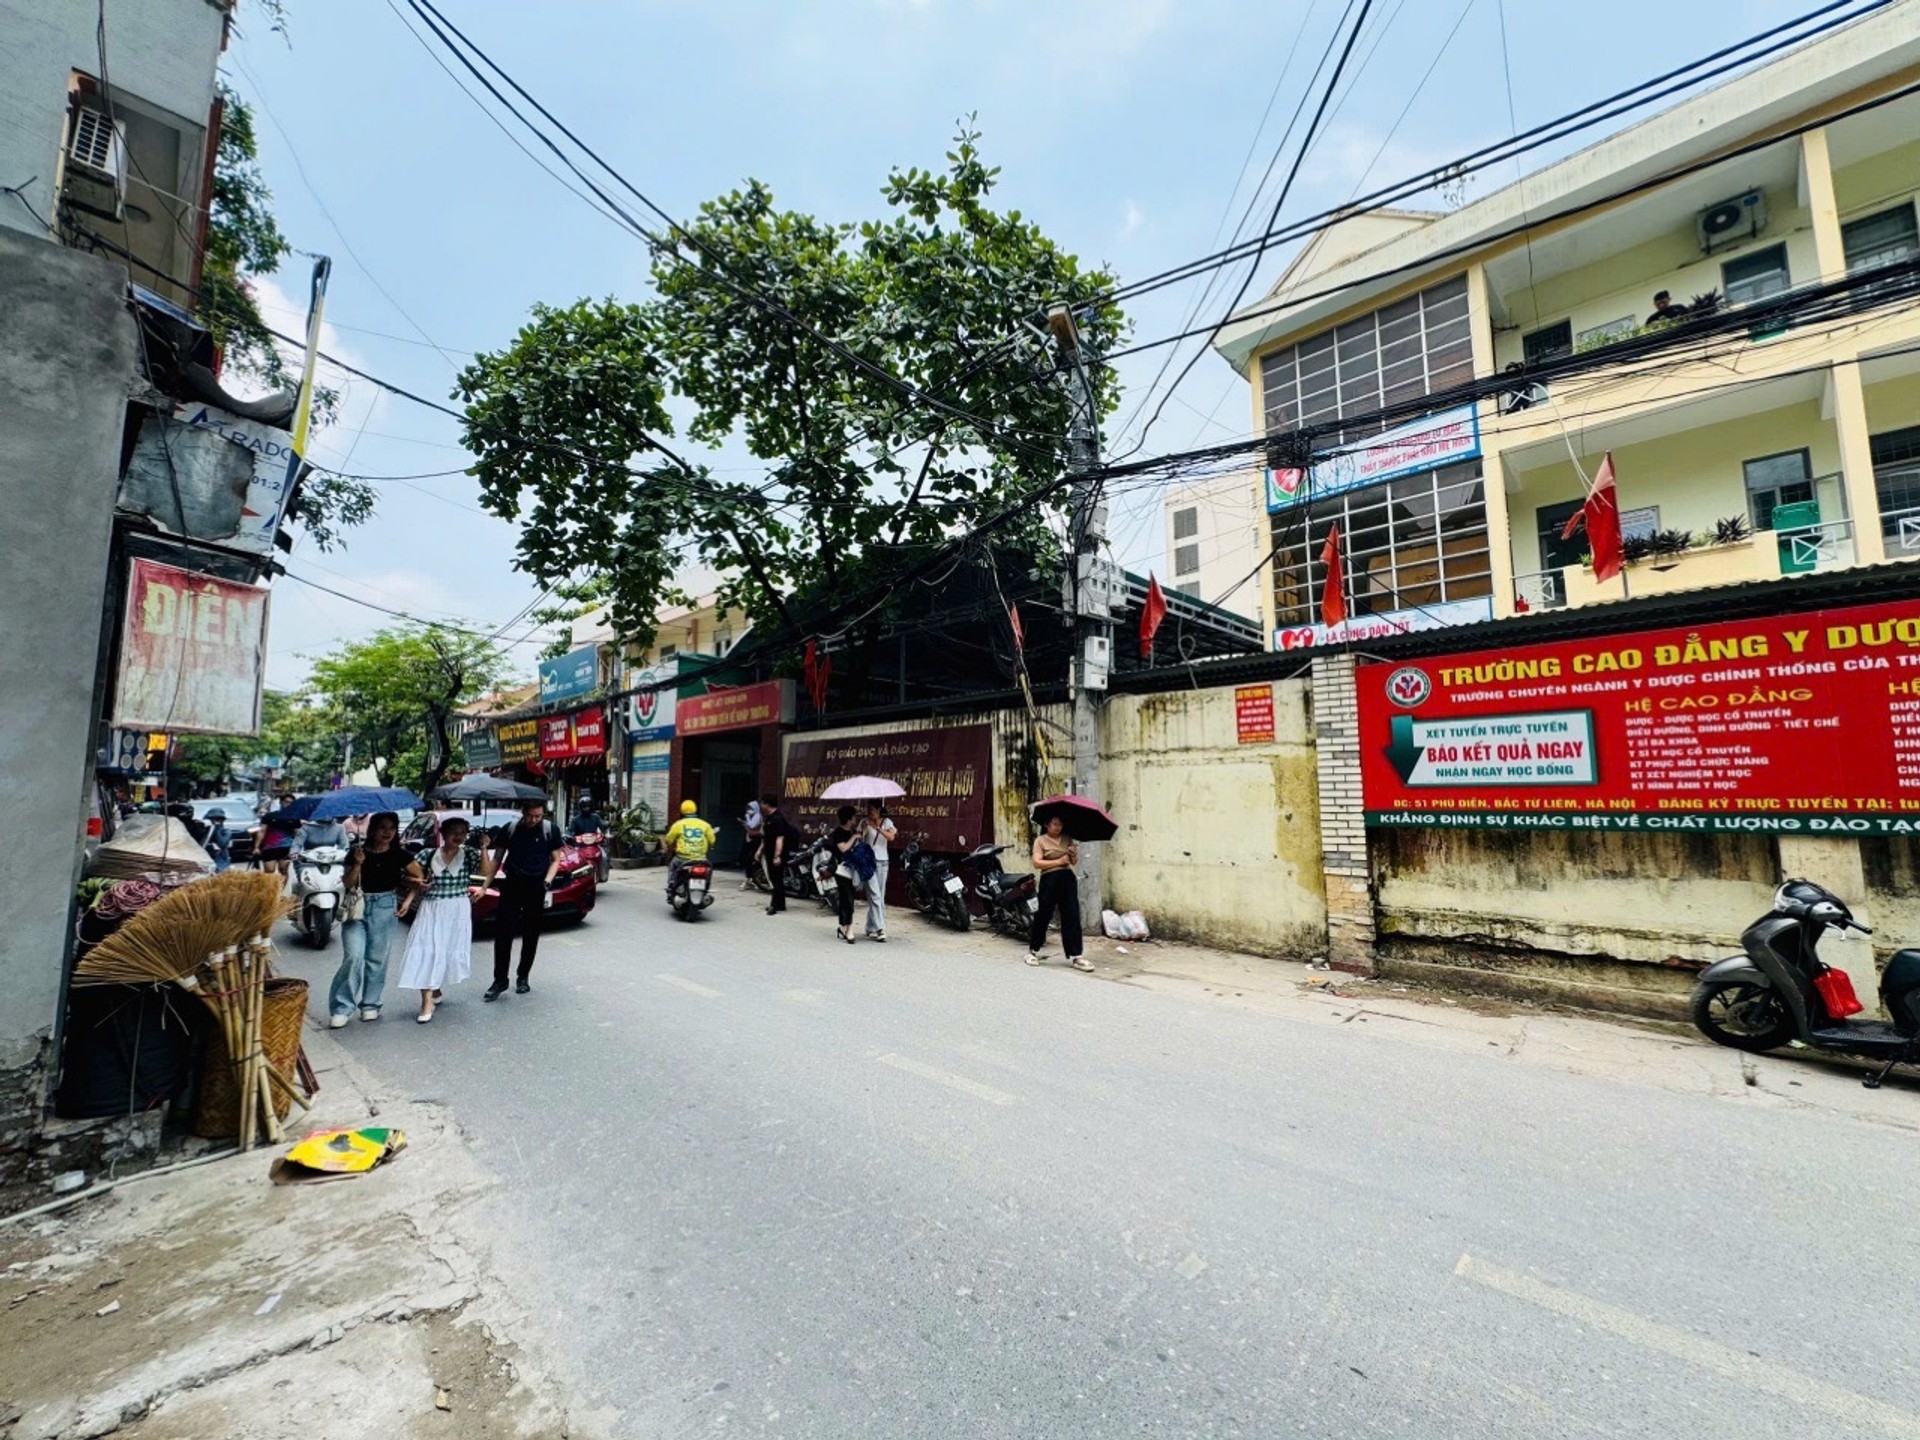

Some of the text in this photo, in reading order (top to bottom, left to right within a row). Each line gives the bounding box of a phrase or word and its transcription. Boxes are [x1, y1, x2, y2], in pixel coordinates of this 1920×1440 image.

[1439, 658, 1561, 687] TRƯỜNG
[1573, 649, 1642, 674] CAO
[1655, 633, 1768, 666] ĐẲNG
[1783, 630, 1809, 653] Y
[1450, 684, 1504, 702] TRƯỜNG
[1508, 682, 1567, 698] CHUYÊN
[1572, 678, 1628, 694] NGÀNH
[1633, 679, 1644, 689] Y
[1648, 674, 1695, 688] DƯỢC
[1702, 667, 1761, 683] CHÍNH
[1766, 661, 1836, 677] THỐNG
[1843, 655, 1889, 671] CỦA
[1625, 686, 1813, 713] HỆ CAO ĐẲNG
[1491, 722, 1522, 737] TRỰC
[1427, 737, 1583, 763] BÁO KẾT QUẢ NGAY
[1628, 739, 1634, 747] Y
[1472, 767, 1503, 778] NGAY
[1507, 767, 1532, 779] HỌC
[1415, 800, 1427, 808] 51
[1586, 798, 1606, 809] HÀ
[1609, 798, 1636, 810] NỘI
[1735, 797, 1780, 810] TRỰC
[1786, 795, 1847, 809] TUYẾN
[1853, 798, 1892, 811] TẠI:
[1440, 814, 1481, 826] ĐỊNH
[1486, 814, 1509, 826] SỰ
[1513, 813, 1566, 826] KHÁC
[1572, 814, 1611, 828] BIỆT
[1615, 813, 1640, 827] VỀ
[1646, 815, 1708, 828] CHẤT
[1715, 817, 1801, 832] LƯỢNG
[1809, 815, 1870, 831] ĐÀO
[682, 825, 704, 839] be
